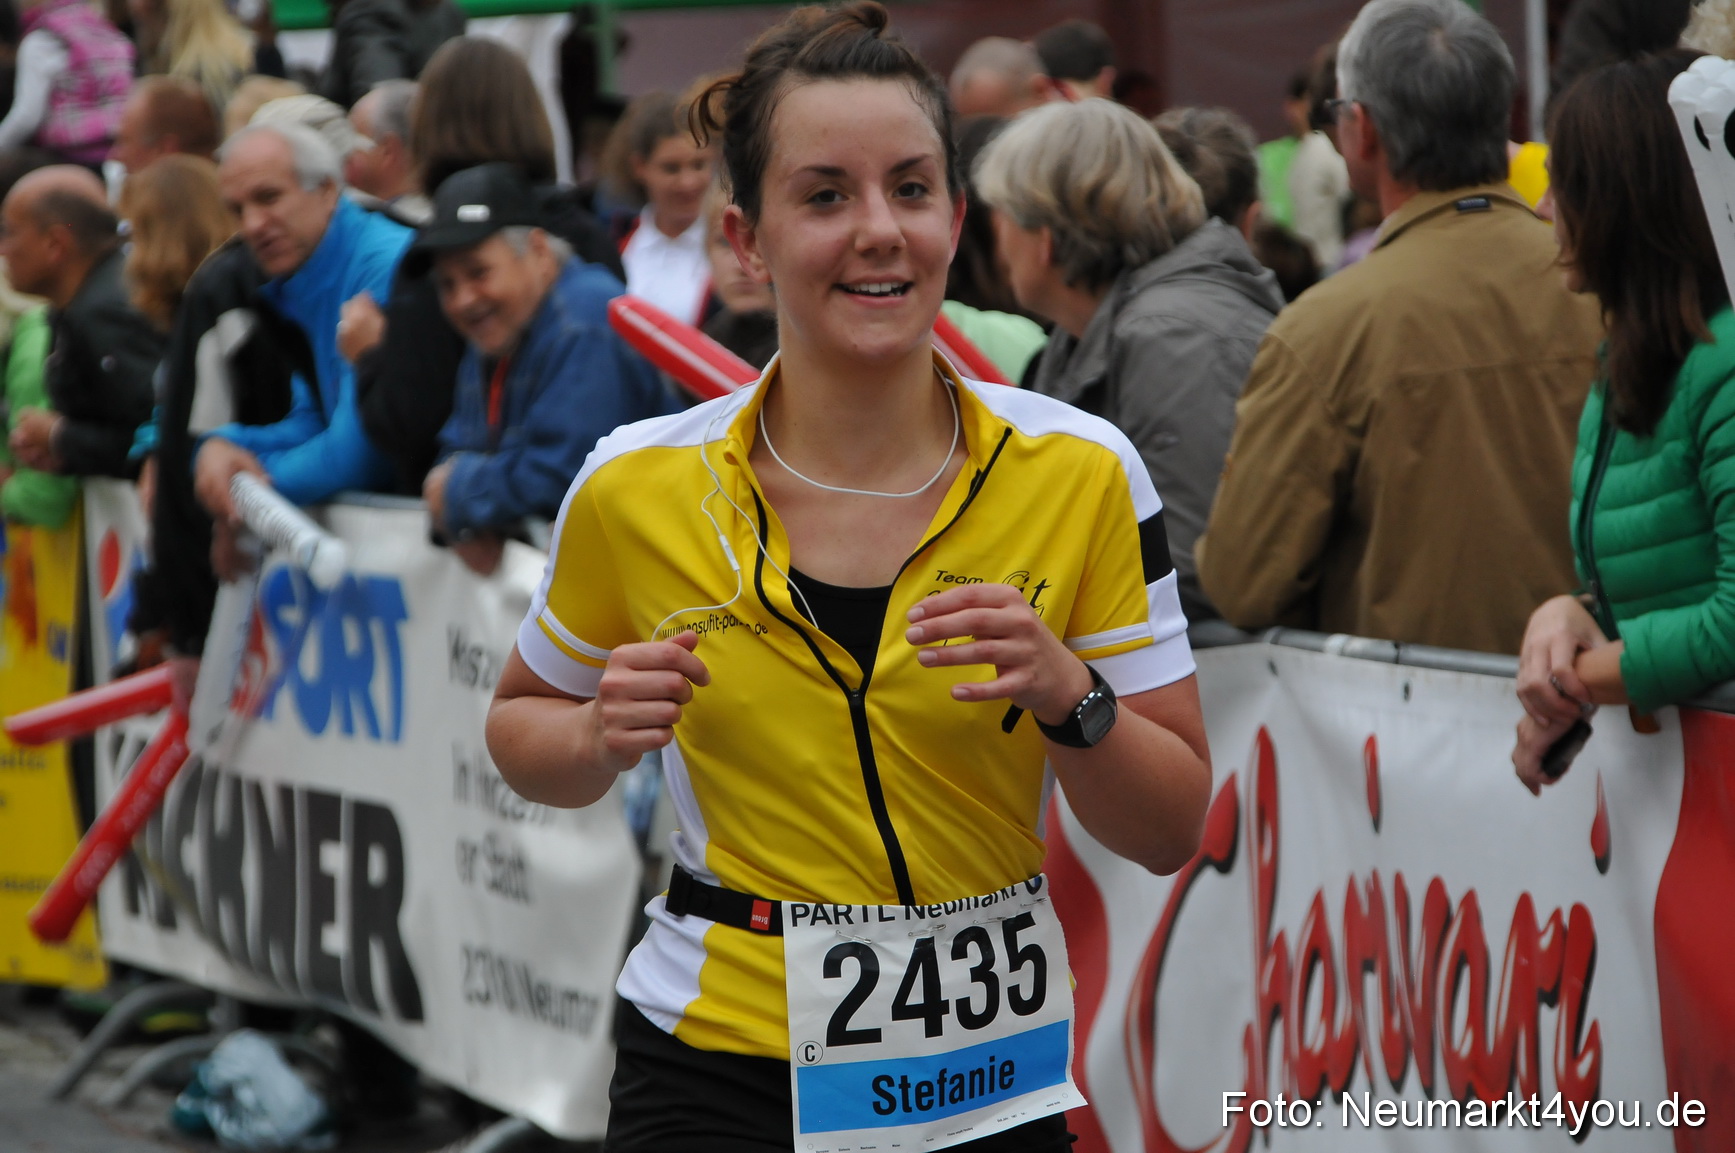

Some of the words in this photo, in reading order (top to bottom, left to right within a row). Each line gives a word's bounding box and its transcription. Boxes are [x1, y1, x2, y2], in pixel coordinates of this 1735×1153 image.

[823, 911, 1048, 1047] 2435
[804, 1045, 816, 1062] C
[872, 1056, 1015, 1115] Stefanie
